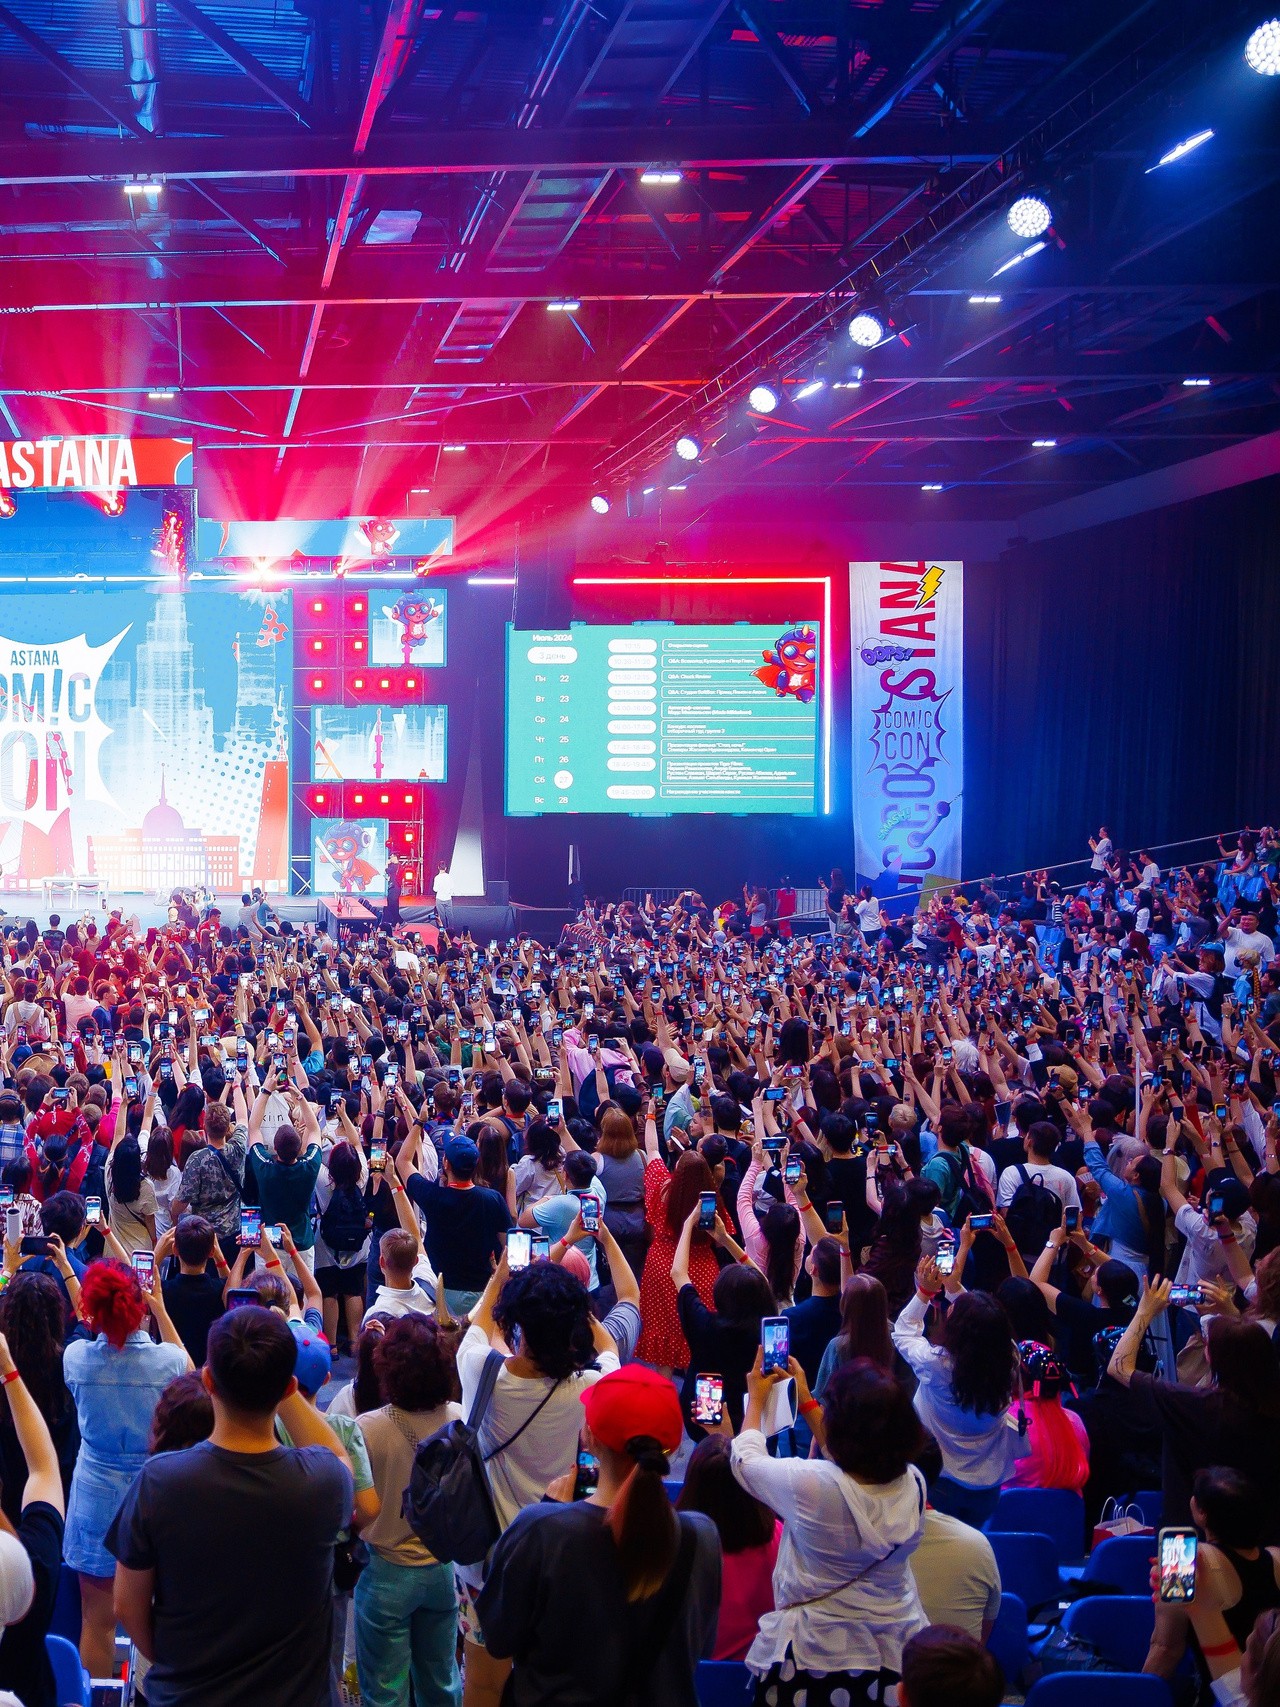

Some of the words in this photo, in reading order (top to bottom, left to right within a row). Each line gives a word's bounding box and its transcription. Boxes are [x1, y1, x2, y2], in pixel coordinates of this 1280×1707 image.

[532, 634, 553, 642] Июль
[553, 634, 573, 642] 2024
[10, 650, 59, 666] ASTANA
[546, 653, 566, 661] день
[860, 645, 915, 666] OOPS!
[535, 674, 546, 683] Пн
[559, 674, 570, 683] 22
[535, 695, 546, 703] Вт
[559, 695, 570, 703] 23
[535, 715, 546, 724] Ср
[559, 715, 570, 724] 24
[535, 735, 546, 743] Чт
[559, 735, 570, 744] 25
[884, 731, 930, 760] CON
[534, 755, 545, 763] Пт
[559, 755, 570, 764] 26
[534, 775, 546, 784] Сб
[534, 796, 545, 804] Вс
[558, 796, 569, 804] 28
[877, 807, 911, 841] SMASH!
